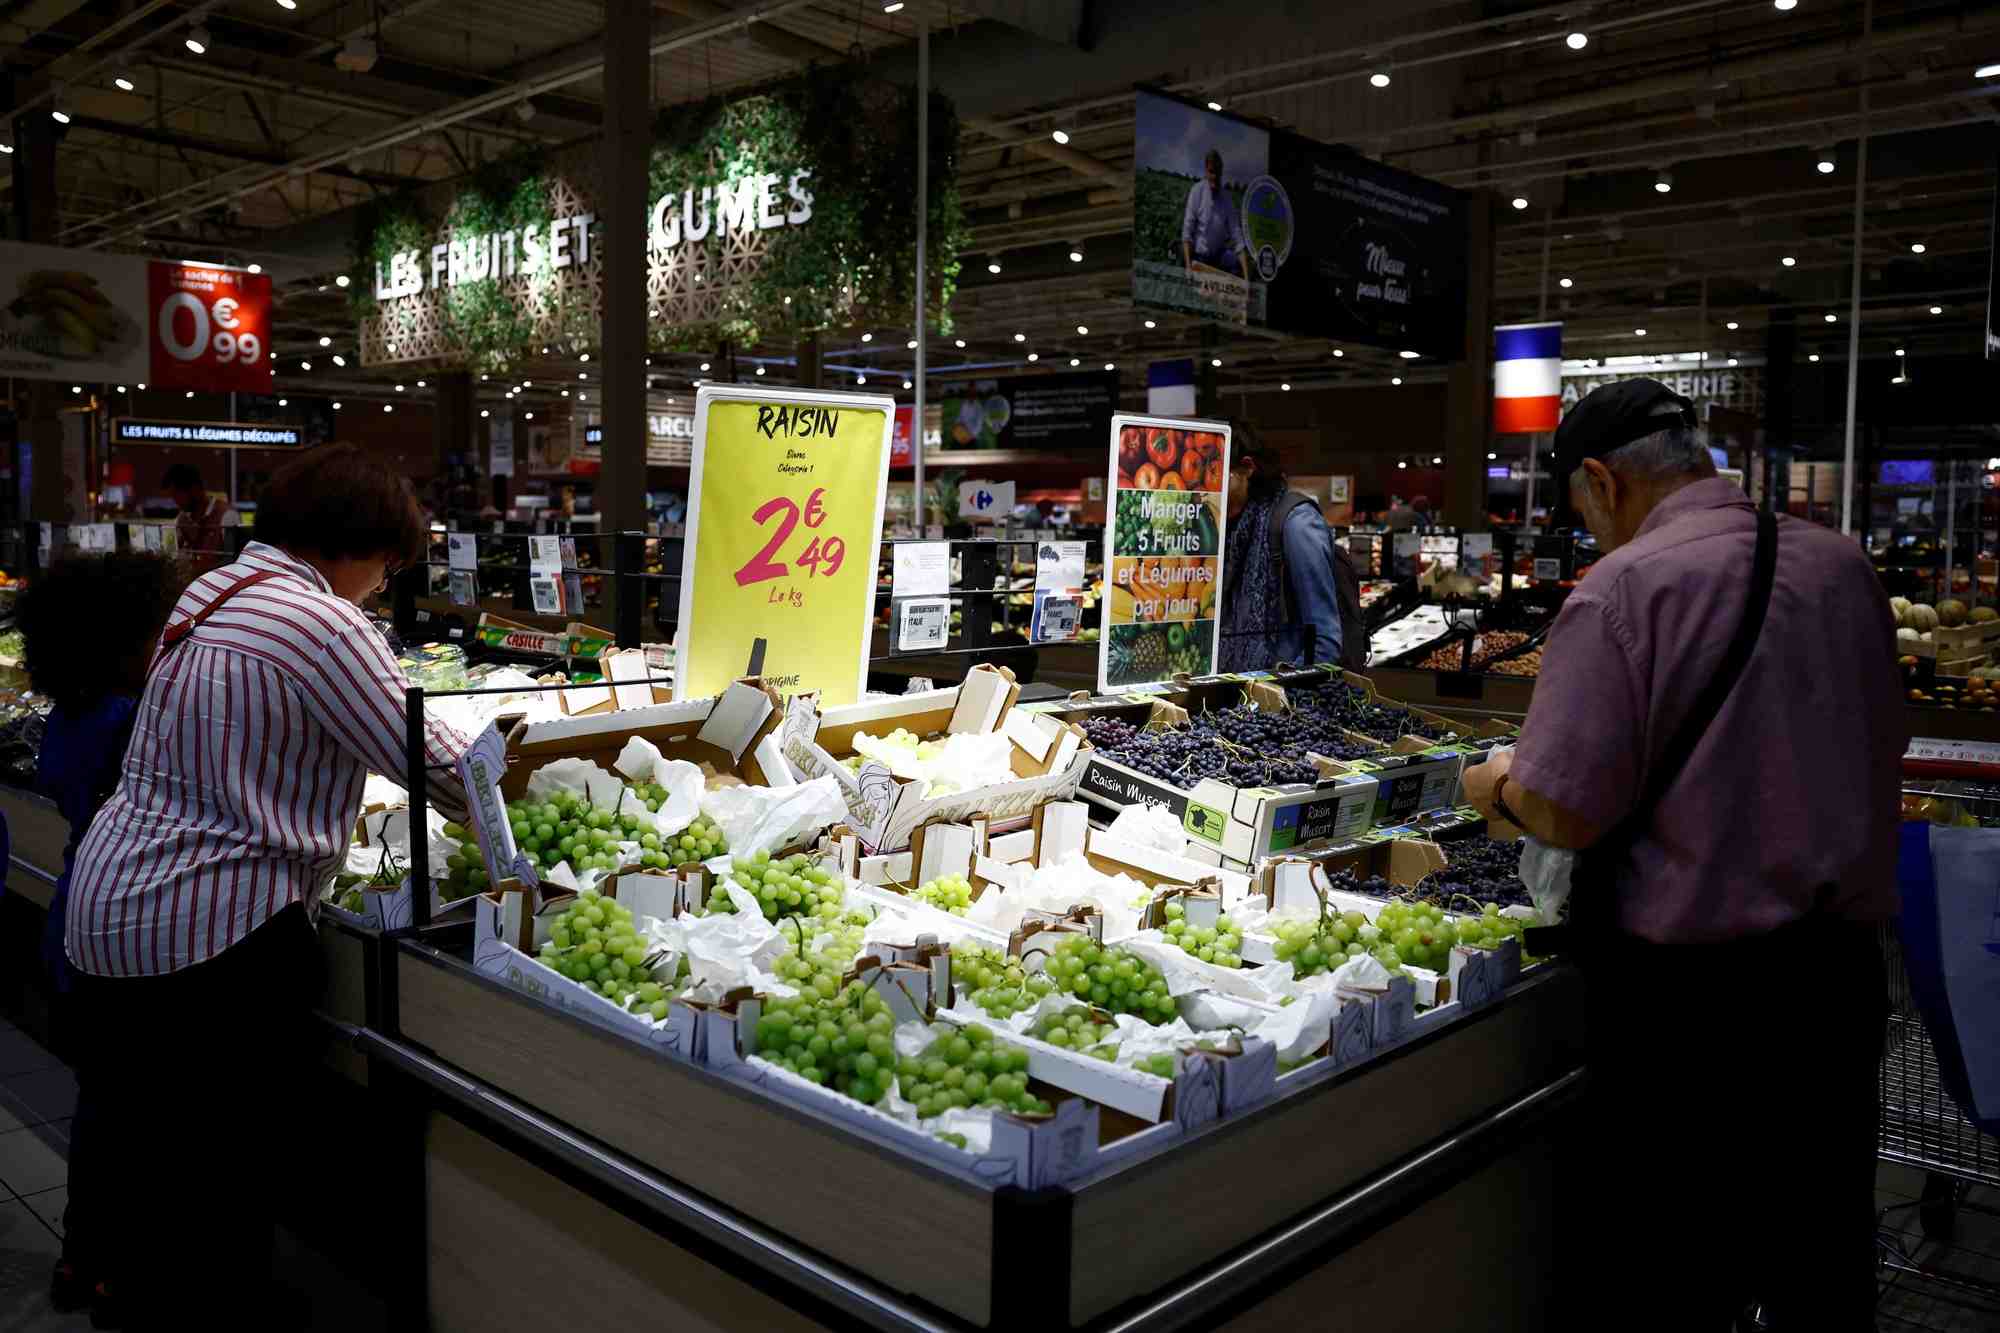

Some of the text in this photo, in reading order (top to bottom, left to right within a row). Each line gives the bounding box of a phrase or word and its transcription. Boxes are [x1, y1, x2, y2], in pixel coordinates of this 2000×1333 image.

[376, 166, 814, 300] LES FRUITS ET GUMES
[159, 292, 261, 365] 0 € 99
[122, 426, 297, 443] LES FRUITS & LÉGUMES DÉCOUPÉS
[648, 415, 695, 438] ARCU
[756, 405, 839, 440] RAISIN
[1140, 496, 1202, 525] Manger
[733, 487, 845, 587] 2 € 49
[1138, 526, 1200, 552] 5 Fruits
[1118, 560, 1213, 588] et Légumes
[767, 586, 803, 608] Le kg
[1132, 592, 1199, 623] par jour
[1090, 768, 1123, 795] Raisin
